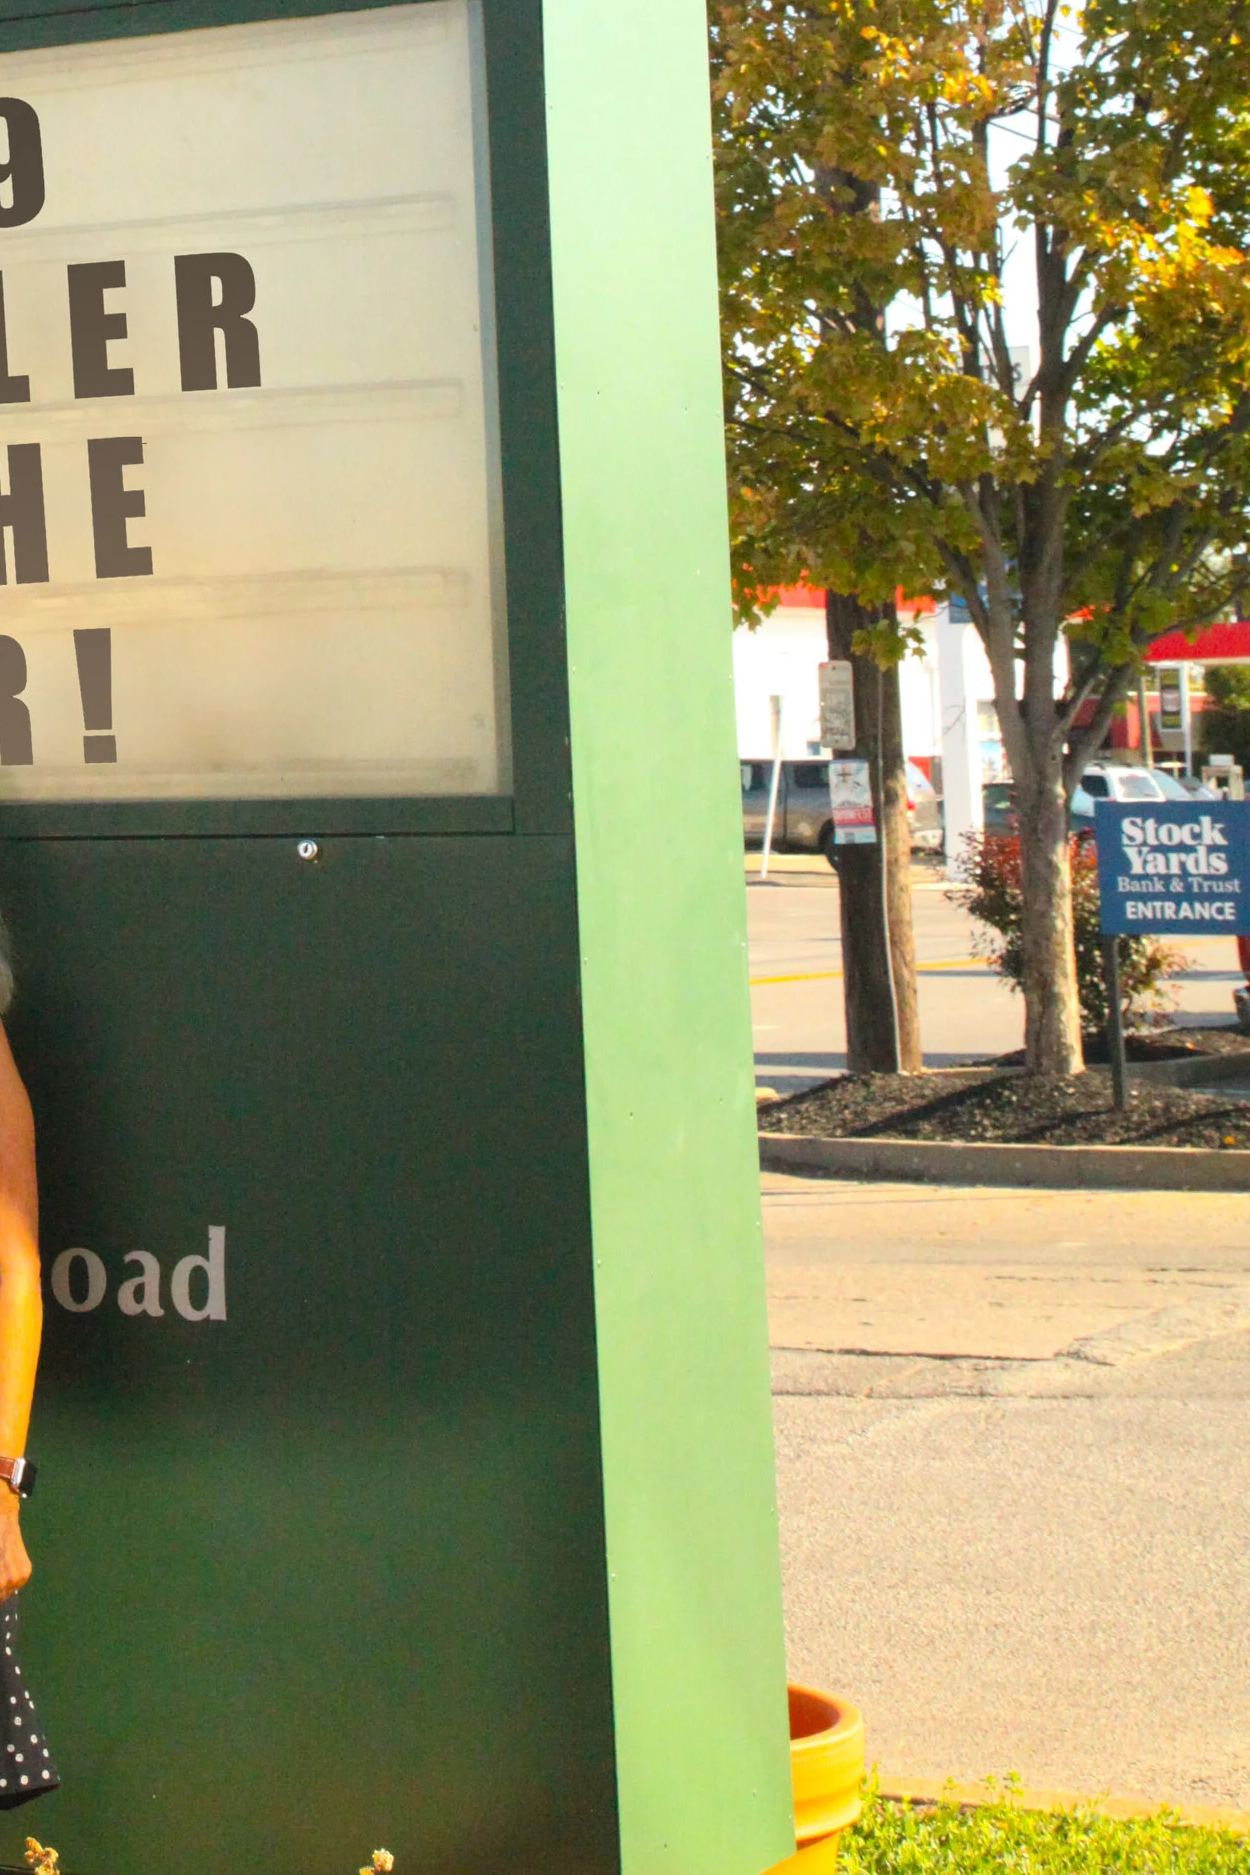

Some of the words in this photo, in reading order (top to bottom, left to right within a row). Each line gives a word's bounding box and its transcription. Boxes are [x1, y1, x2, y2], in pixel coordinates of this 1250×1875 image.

[1121, 814, 1229, 845] Stock
[1122, 844, 1229, 875] Yards
[1117, 876, 1166, 893] Bank
[1169, 876, 1184, 893] &
[1188, 876, 1241, 893] Trust
[1125, 900, 1237, 921] ENTRANCE
[51, 1224, 228, 1323] oad
